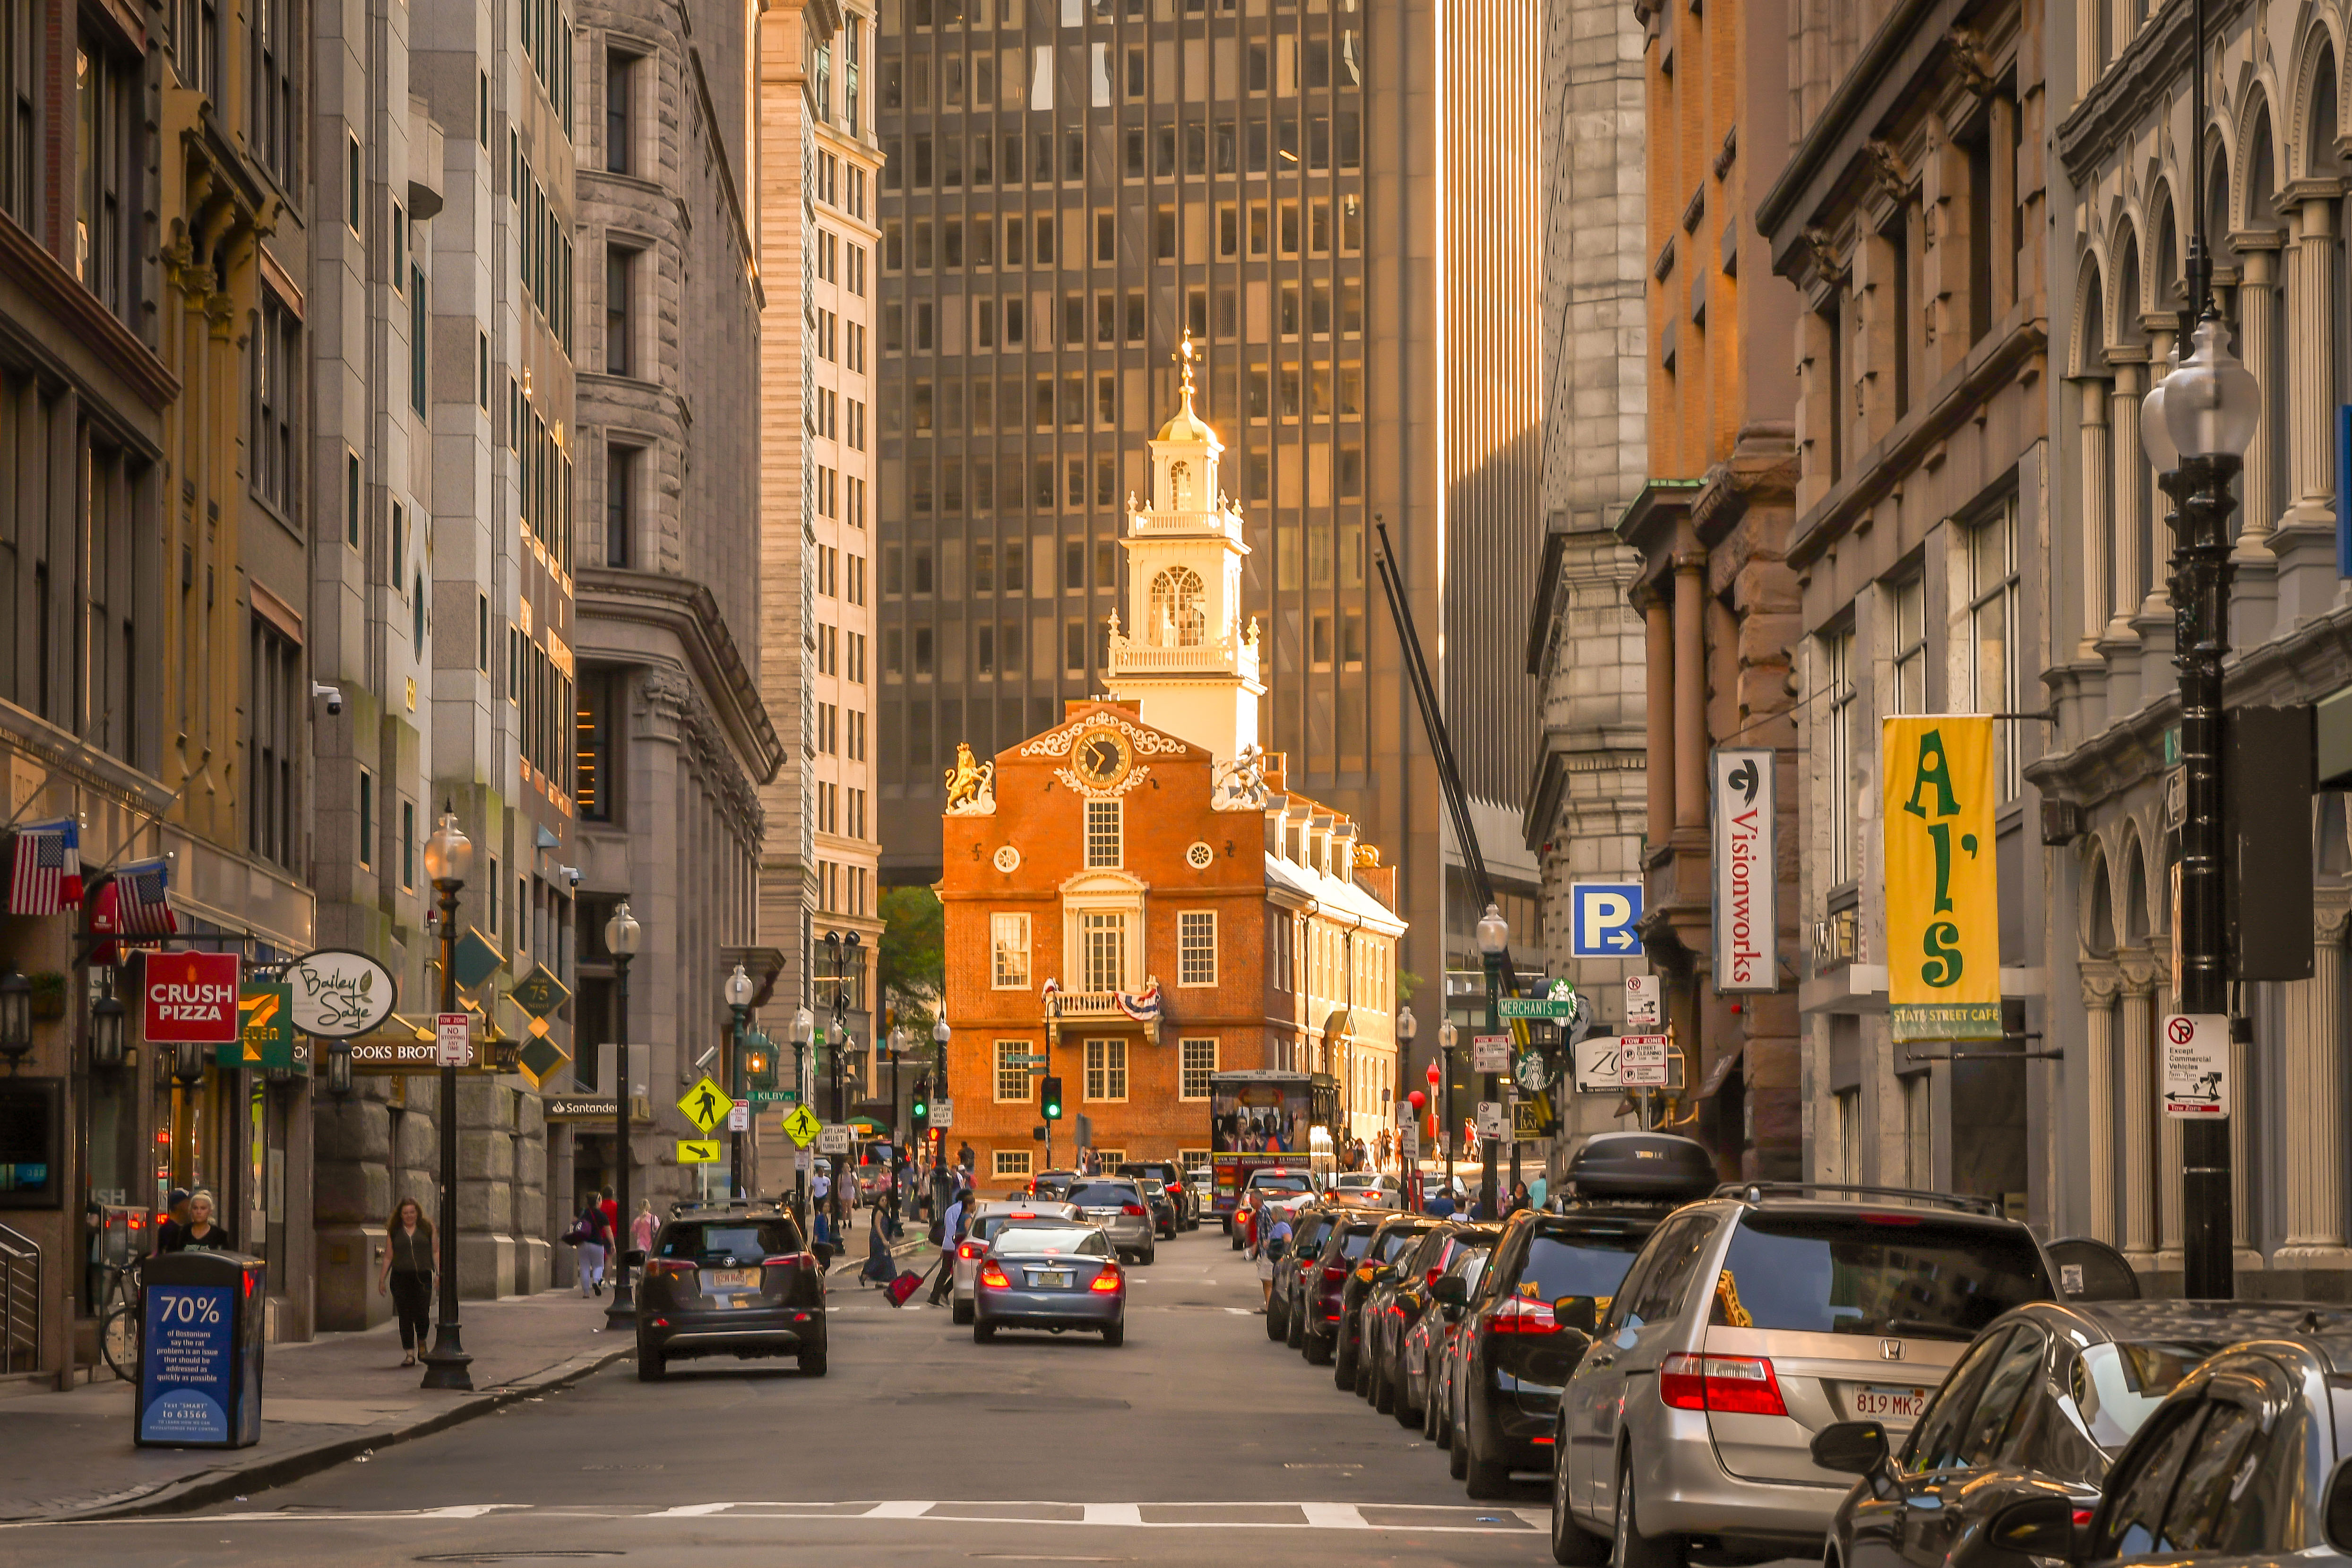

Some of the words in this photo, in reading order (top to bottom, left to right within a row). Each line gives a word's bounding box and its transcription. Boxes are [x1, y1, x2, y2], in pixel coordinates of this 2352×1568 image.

[1732, 807, 1762, 983] Visionworks
[1584, 892, 1631, 948] P
[150, 983, 233, 1003] CRUSH
[300, 967, 356, 1008] Bailey
[530, 985, 548, 1000] 75
[159, 1005, 222, 1021] PIZZA
[317, 991, 372, 1029] Sage
[1501, 1001, 1553, 1016] MERCHANTS
[1930, 1009, 1968, 1021] STREET
[351, 1045, 393, 1060] OOKS
[397, 1045, 474, 1060] BROTS
[758, 1092, 784, 1101] KILBY
[161, 1296, 220, 1323] 70%
[176, 1330, 211, 1338] Bostonians
[166, 1365, 198, 1373] addressed
[157, 1373, 180, 1382] quickly
[191, 1374, 217, 1383] possible
[1857, 1394, 1887, 1413] 819
[1892, 1396, 1923, 1416] MK2
[177, 1411, 207, 1419] 63566
